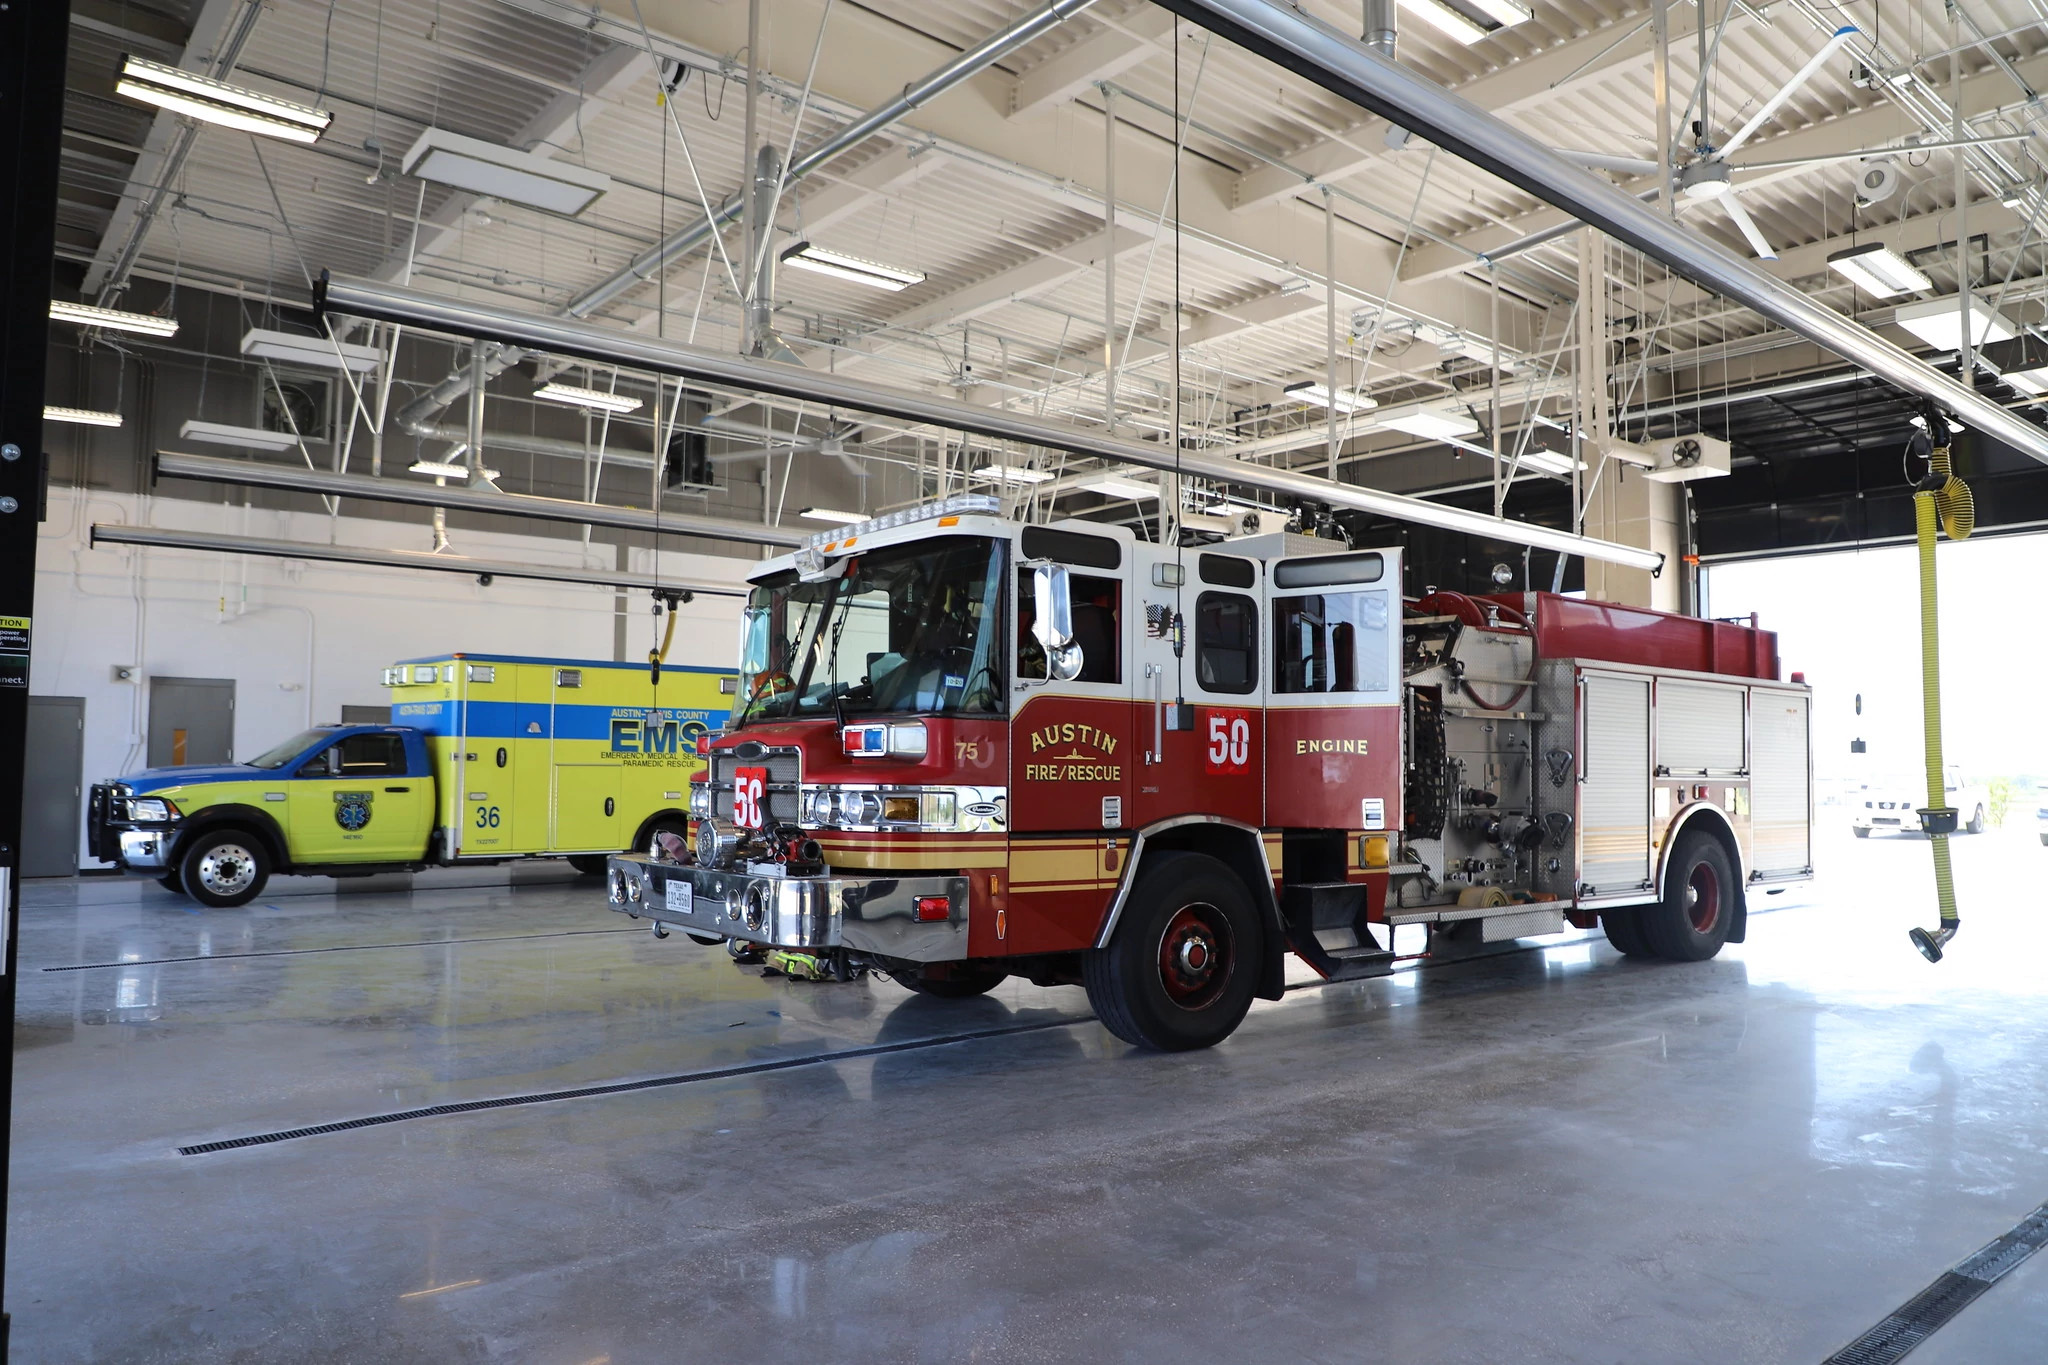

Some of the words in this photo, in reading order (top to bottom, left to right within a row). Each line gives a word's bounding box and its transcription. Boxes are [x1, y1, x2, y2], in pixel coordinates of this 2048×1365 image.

[611, 708, 673, 719] AUSTIN-VIS
[676, 711, 710, 720] COUNTY
[610, 719, 708, 753] EMS
[1031, 723, 1118, 755] AUSTIN
[1209, 717, 1249, 765] 50
[955, 742, 979, 760] 75
[1296, 739, 1368, 755] ENGINE
[601, 752, 644, 760] EMERGENCY
[647, 752, 678, 760] MEDICAL
[623, 760, 664, 768] PARAMEDIC
[667, 760, 696, 768] RESCUE
[1026, 764, 1121, 781] FIRE/RESCUE
[734, 777, 763, 829] 50
[476, 806, 500, 829] 36
[788, 961, 795, 973] R
